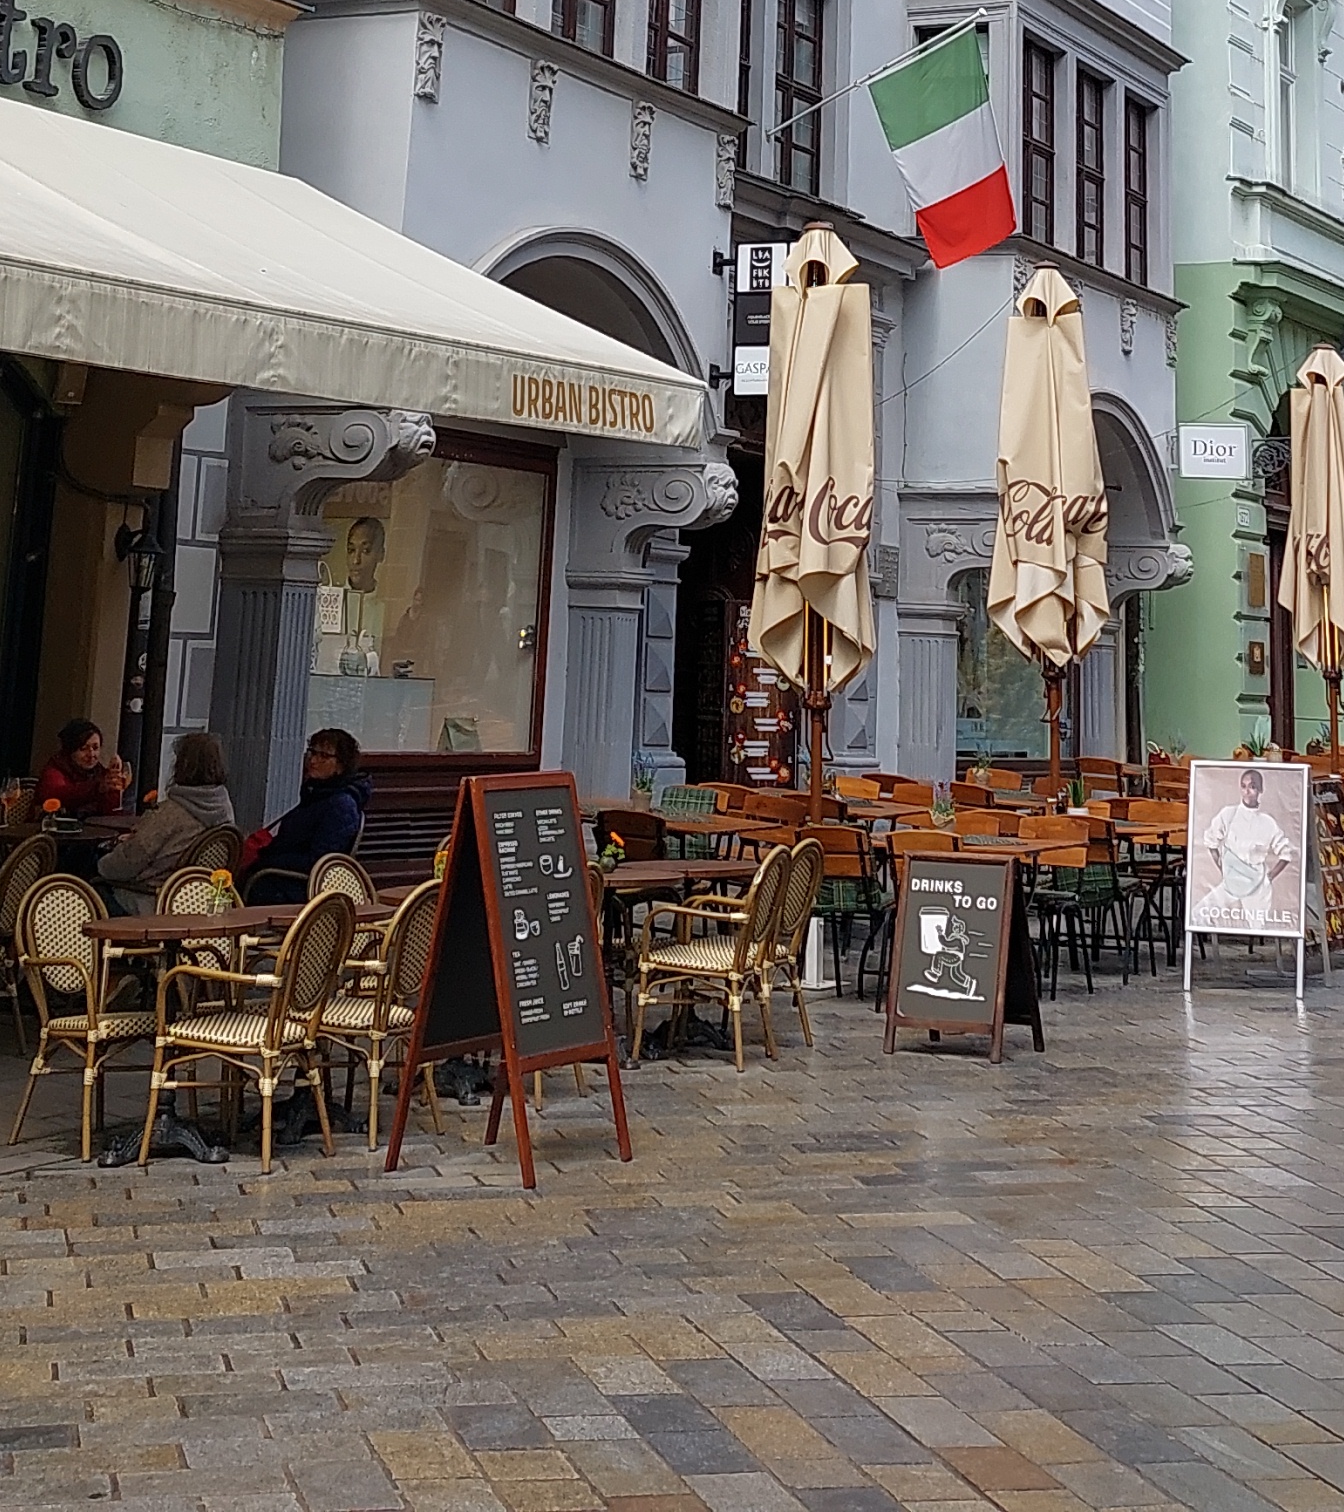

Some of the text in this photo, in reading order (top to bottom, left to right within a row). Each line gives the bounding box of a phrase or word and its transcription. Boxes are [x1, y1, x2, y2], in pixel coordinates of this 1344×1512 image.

[512, 374, 654, 433] URBAN BISTRO
[1191, 440, 1236, 457] Dior
[911, 878, 963, 894] DRINKS
[953, 895, 997, 910] TO GO
[1199, 906, 1292, 923] COCCINELLE
